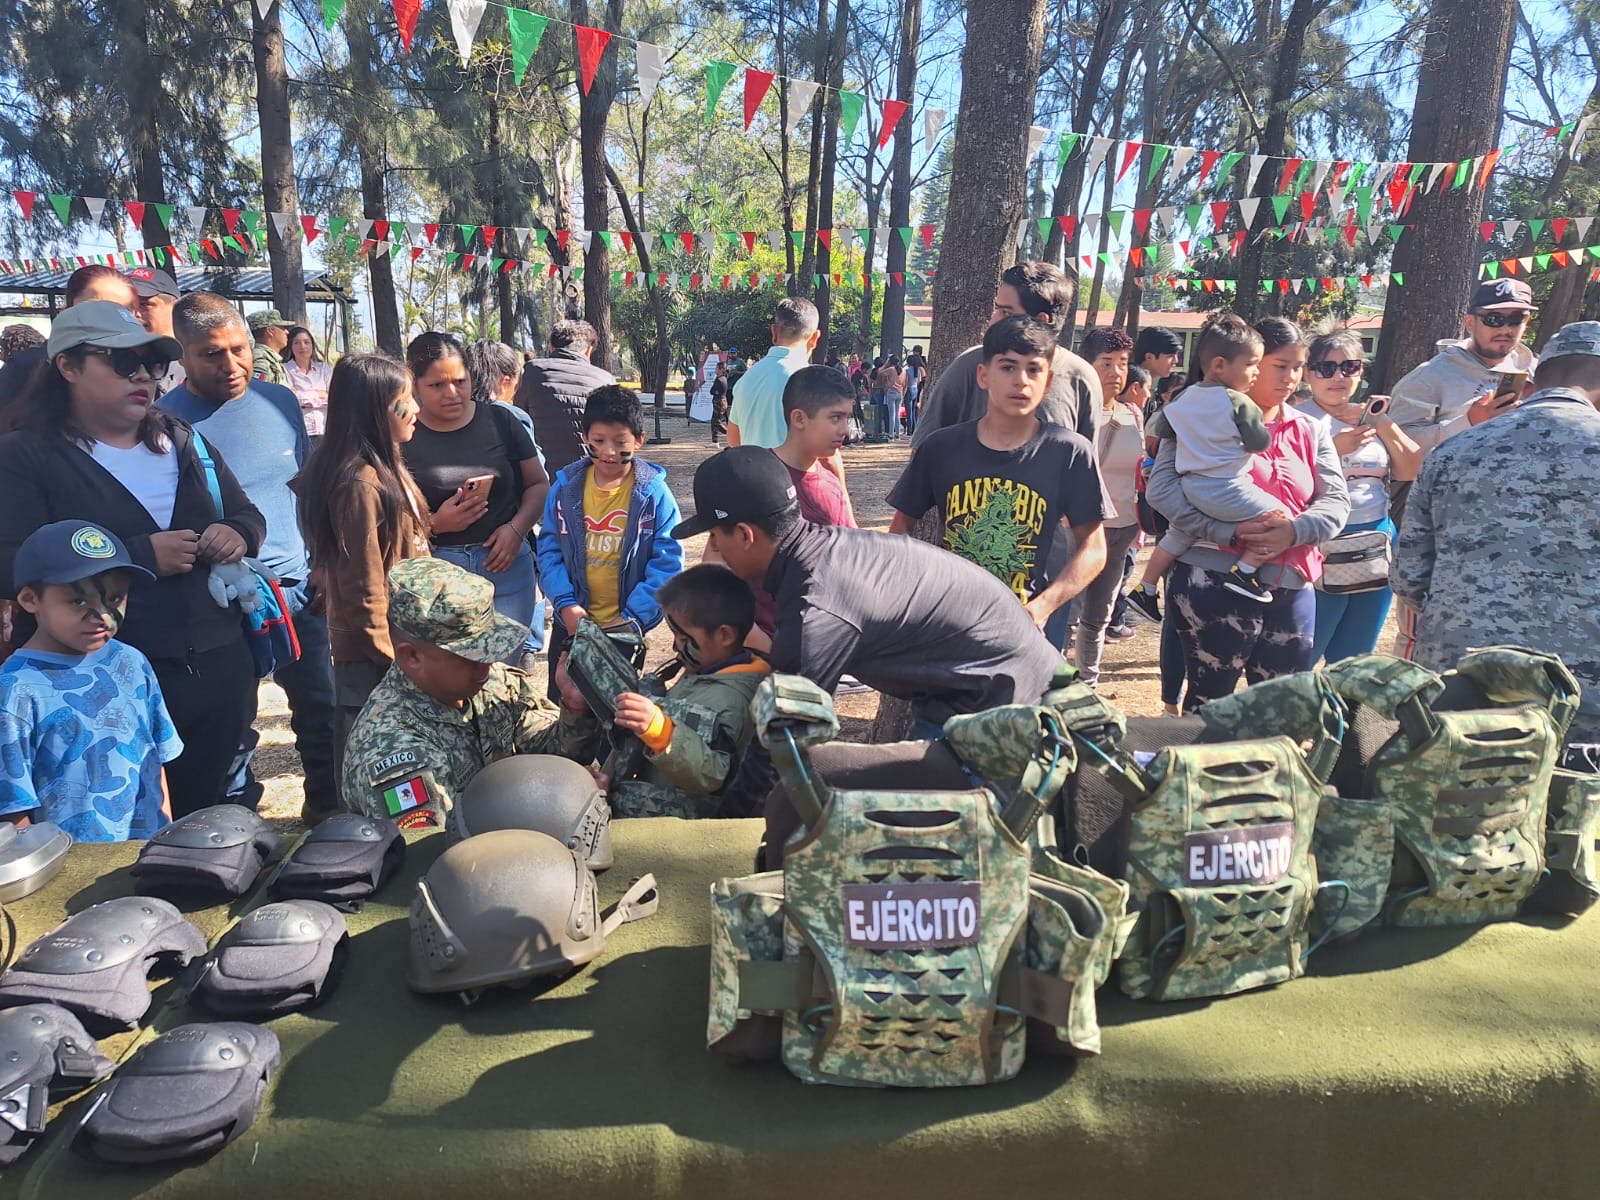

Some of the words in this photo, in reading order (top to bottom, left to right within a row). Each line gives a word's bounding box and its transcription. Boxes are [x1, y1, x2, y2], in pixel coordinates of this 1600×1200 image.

[375, 752, 414, 773] MEXICO
[1189, 835, 1292, 880] EJÉRCITO
[848, 890, 977, 942] EJÉRCITO
